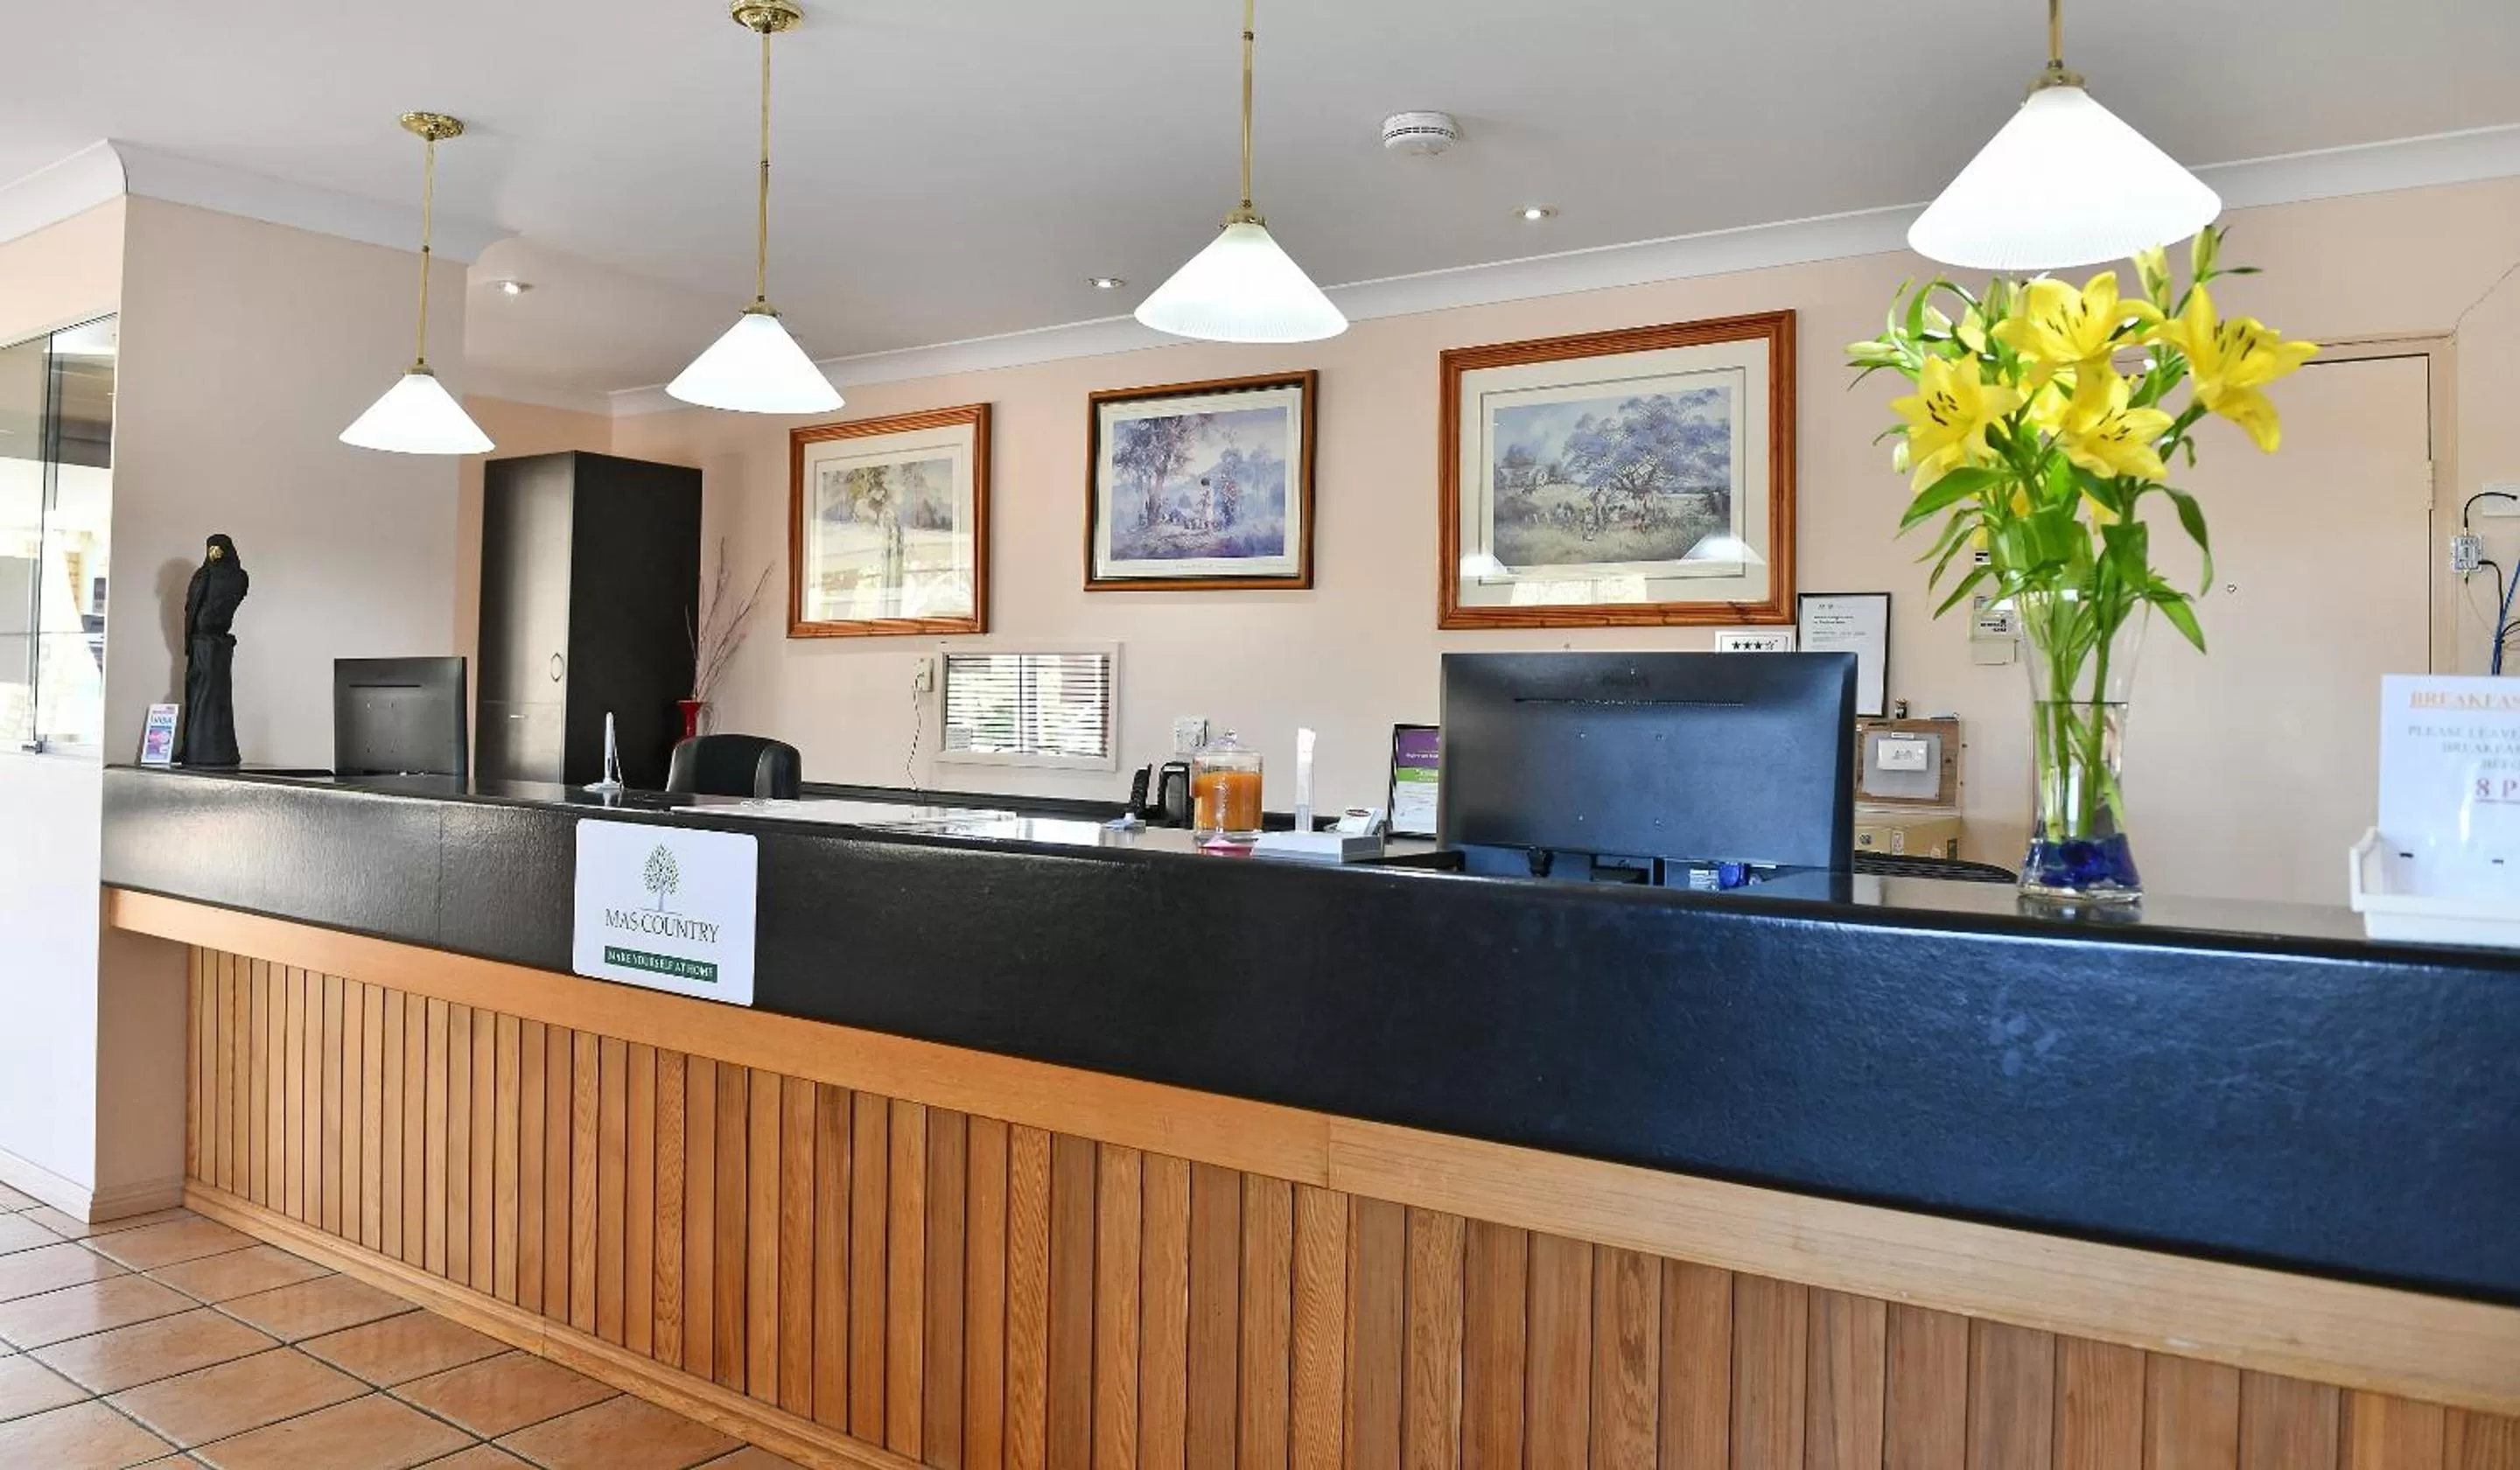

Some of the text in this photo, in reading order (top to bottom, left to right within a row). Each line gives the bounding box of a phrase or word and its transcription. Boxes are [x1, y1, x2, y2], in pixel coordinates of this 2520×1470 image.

[2474, 778, 2490, 798] 8
[606, 908, 719, 943] MAS COUNTRY
[608, 949, 714, 977] MAKE YOURSELF AT HOME
